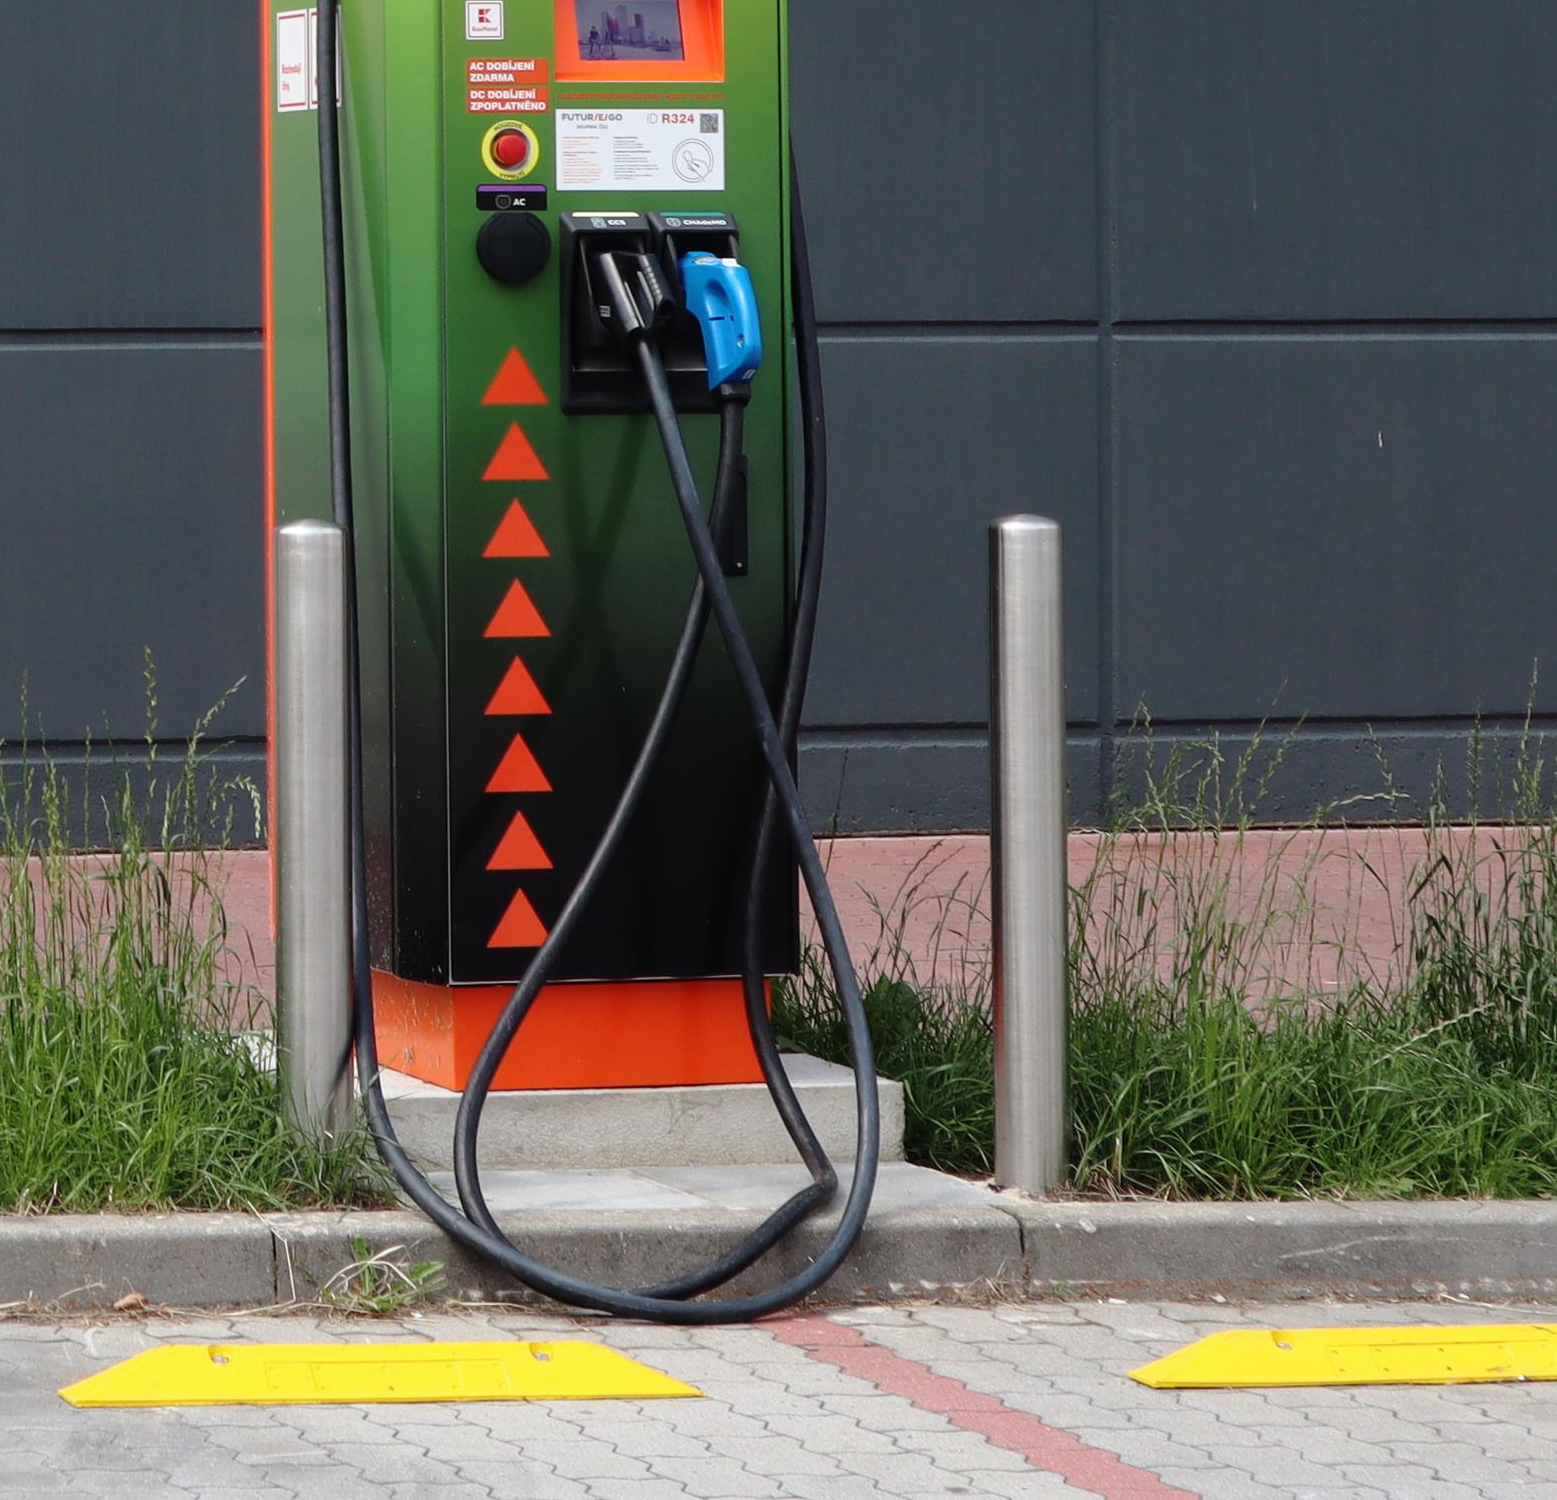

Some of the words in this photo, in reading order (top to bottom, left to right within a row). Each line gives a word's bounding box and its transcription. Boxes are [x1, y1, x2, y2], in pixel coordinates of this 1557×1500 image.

[469, 61, 485, 71] AC
[486, 59, 536, 71] DOBÍJENÍ
[469, 73, 515, 82] ZDARMA
[470, 90, 486, 99] DC
[487, 88, 537, 99] DOBÍJENÍ
[469, 100, 547, 111] ZPOPLATNĚNO
[661, 113, 695, 124] R324
[512, 198, 527, 206] AC
